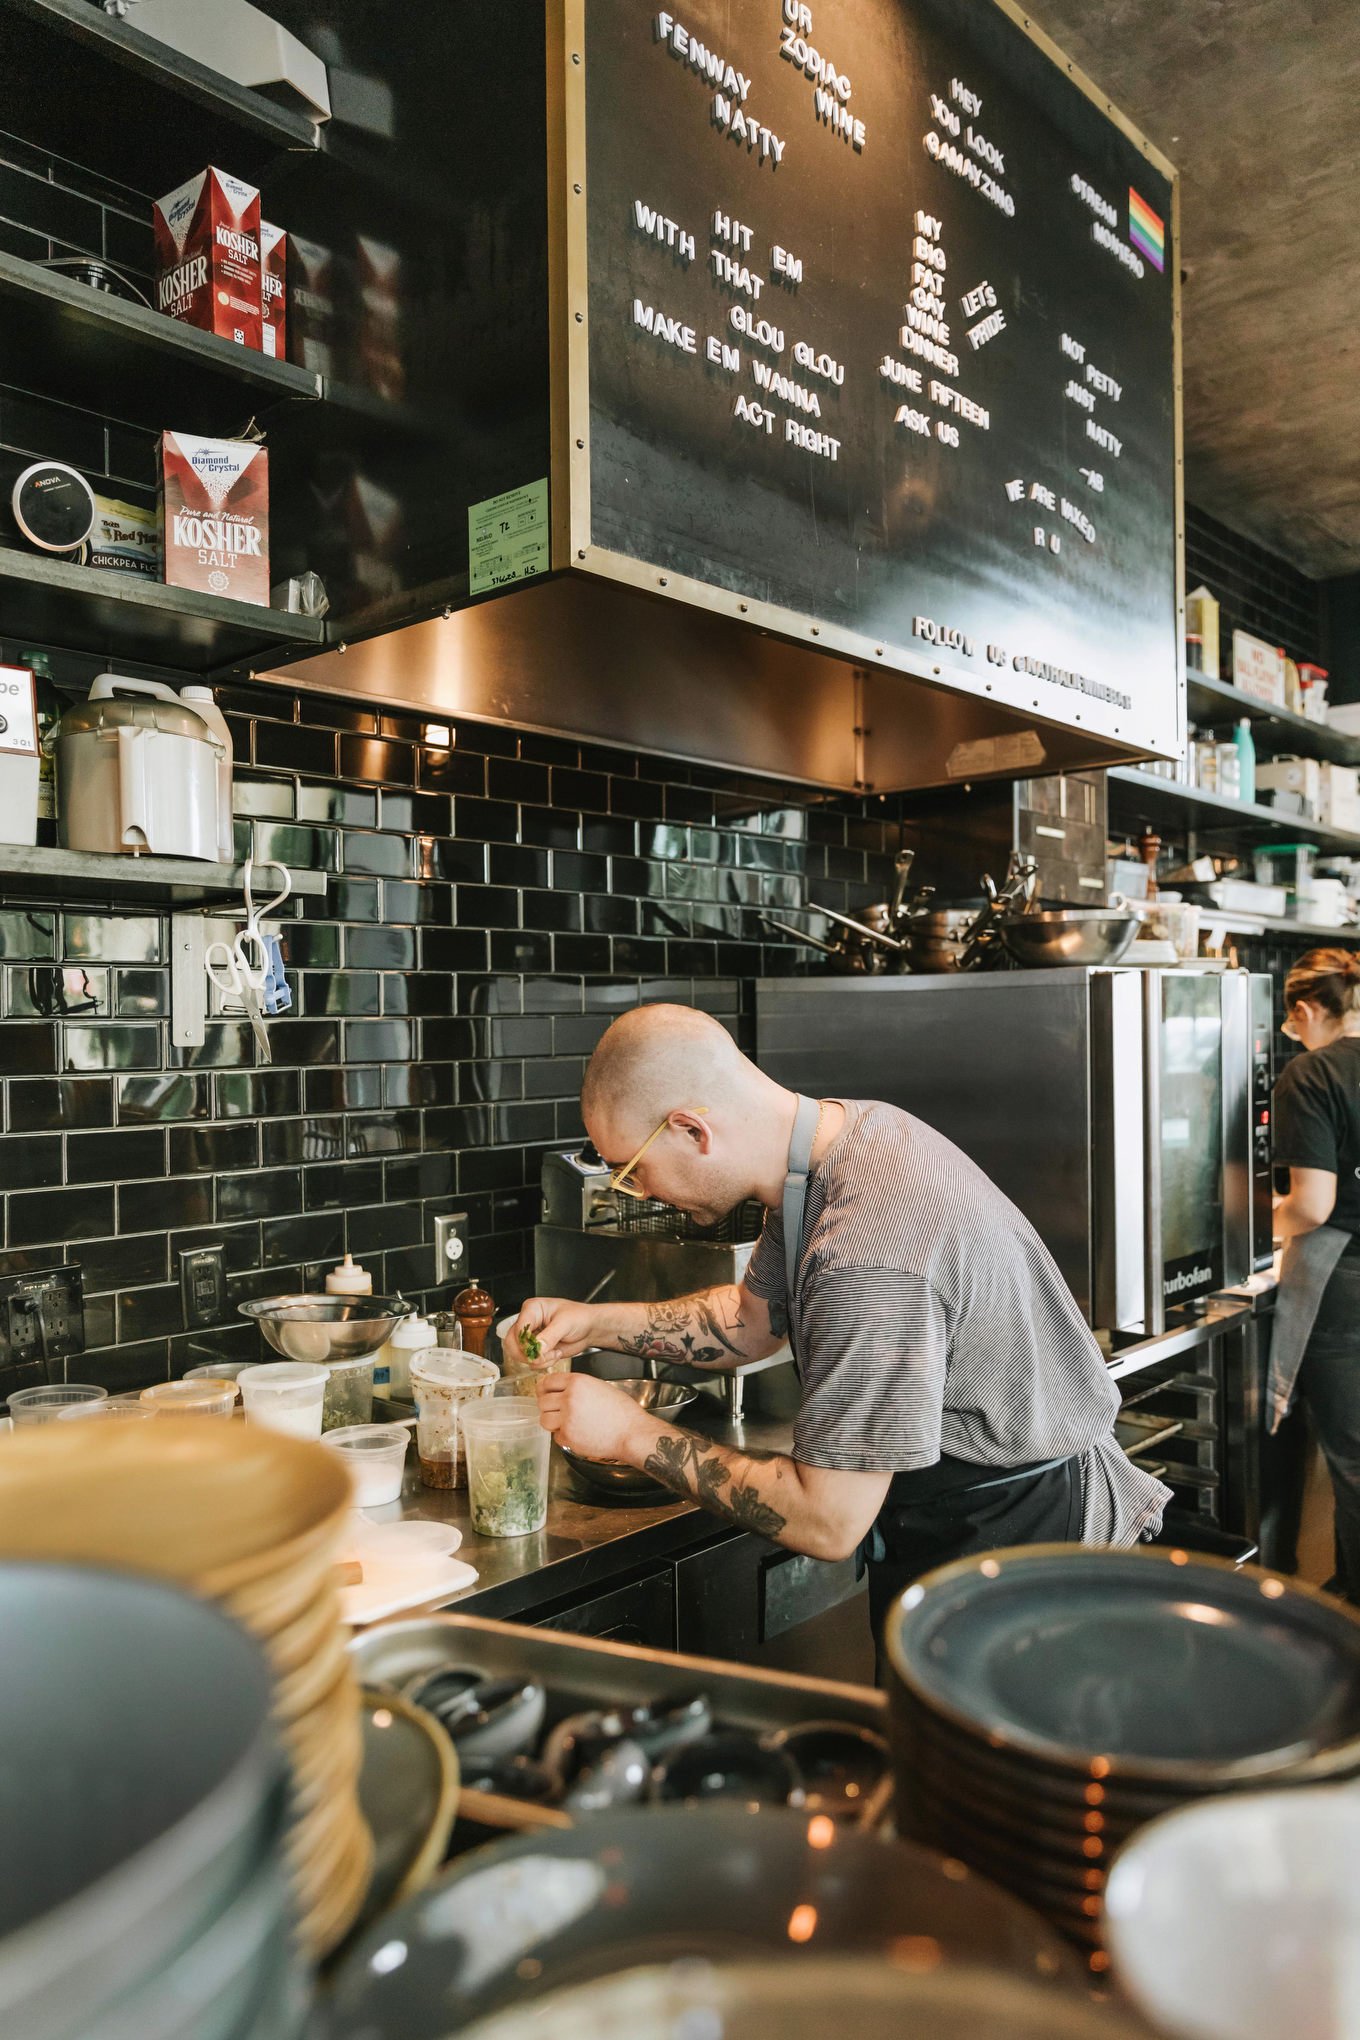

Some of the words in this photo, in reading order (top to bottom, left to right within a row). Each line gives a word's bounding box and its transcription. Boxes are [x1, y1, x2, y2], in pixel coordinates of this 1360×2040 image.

[783, 0, 812, 33] UR
[657, 12, 751, 101] FENWAY
[780, 27, 852, 100] ZODIAC
[815, 88, 866, 146] WINE
[950, 77, 983, 118] HEY
[714, 93, 786, 162] NATTY
[930, 94, 960, 136] YOU
[966, 126, 1005, 174] LOOK
[215, 225, 259, 263] KOSHER
[914, 210, 943, 241] MY
[228, 248, 249, 265] SALT
[634, 200, 696, 261] WITH
[711, 250, 765, 300] THAT
[714, 210, 754, 251] HIT
[771, 245, 803, 283] EM
[912, 235, 947, 271] BIG
[159, 255, 208, 311] KOSHER
[262, 274, 283, 298] HER
[911, 262, 945, 296] FAT
[170, 292, 194, 318] SALT
[910, 287, 946, 321] GAY
[904, 303, 950, 346] WINE
[965, 309, 1007, 350] PRIDE
[634, 299, 697, 354] MAKE
[706, 336, 740, 373] EM
[752, 360, 821, 418] WANNA
[729, 305, 785, 353] GLOU
[793, 342, 845, 385] GLOU
[900, 325, 960, 377] DINNER
[1060, 333, 1086, 364] NOT
[879, 355, 923, 393] JUNE
[928, 379, 990, 430] FIFTEEN
[1064, 379, 1096, 413] JUST
[1086, 363, 1123, 402] PETTY
[734, 395, 776, 434] ACT
[785, 419, 841, 461] RIGHT
[895, 405, 931, 437] ASK
[935, 421, 960, 448] US
[1086, 418, 1123, 458] NATTY
[192, 455, 229, 465] Diamond
[208, 463, 240, 474] Crystal
[34, 476, 61, 488] ANOVA
[1005, 479, 1025, 502] WE
[1030, 482, 1056, 512] ARE
[179, 504, 201, 517] Pure
[203, 511, 220, 520] and
[221, 511, 254, 525] Natural
[113, 528, 136, 543] Red
[173, 515, 262, 557] KOSHER
[1033, 526, 1046, 547] R
[1049, 533, 1061, 555] U
[91, 555, 137, 569] CHICKPEA
[140, 564, 158, 576] FLO
[198, 549, 238, 569] SALT
[913, 616, 976, 657] FOLLOW
[986, 644, 1007, 667] US
